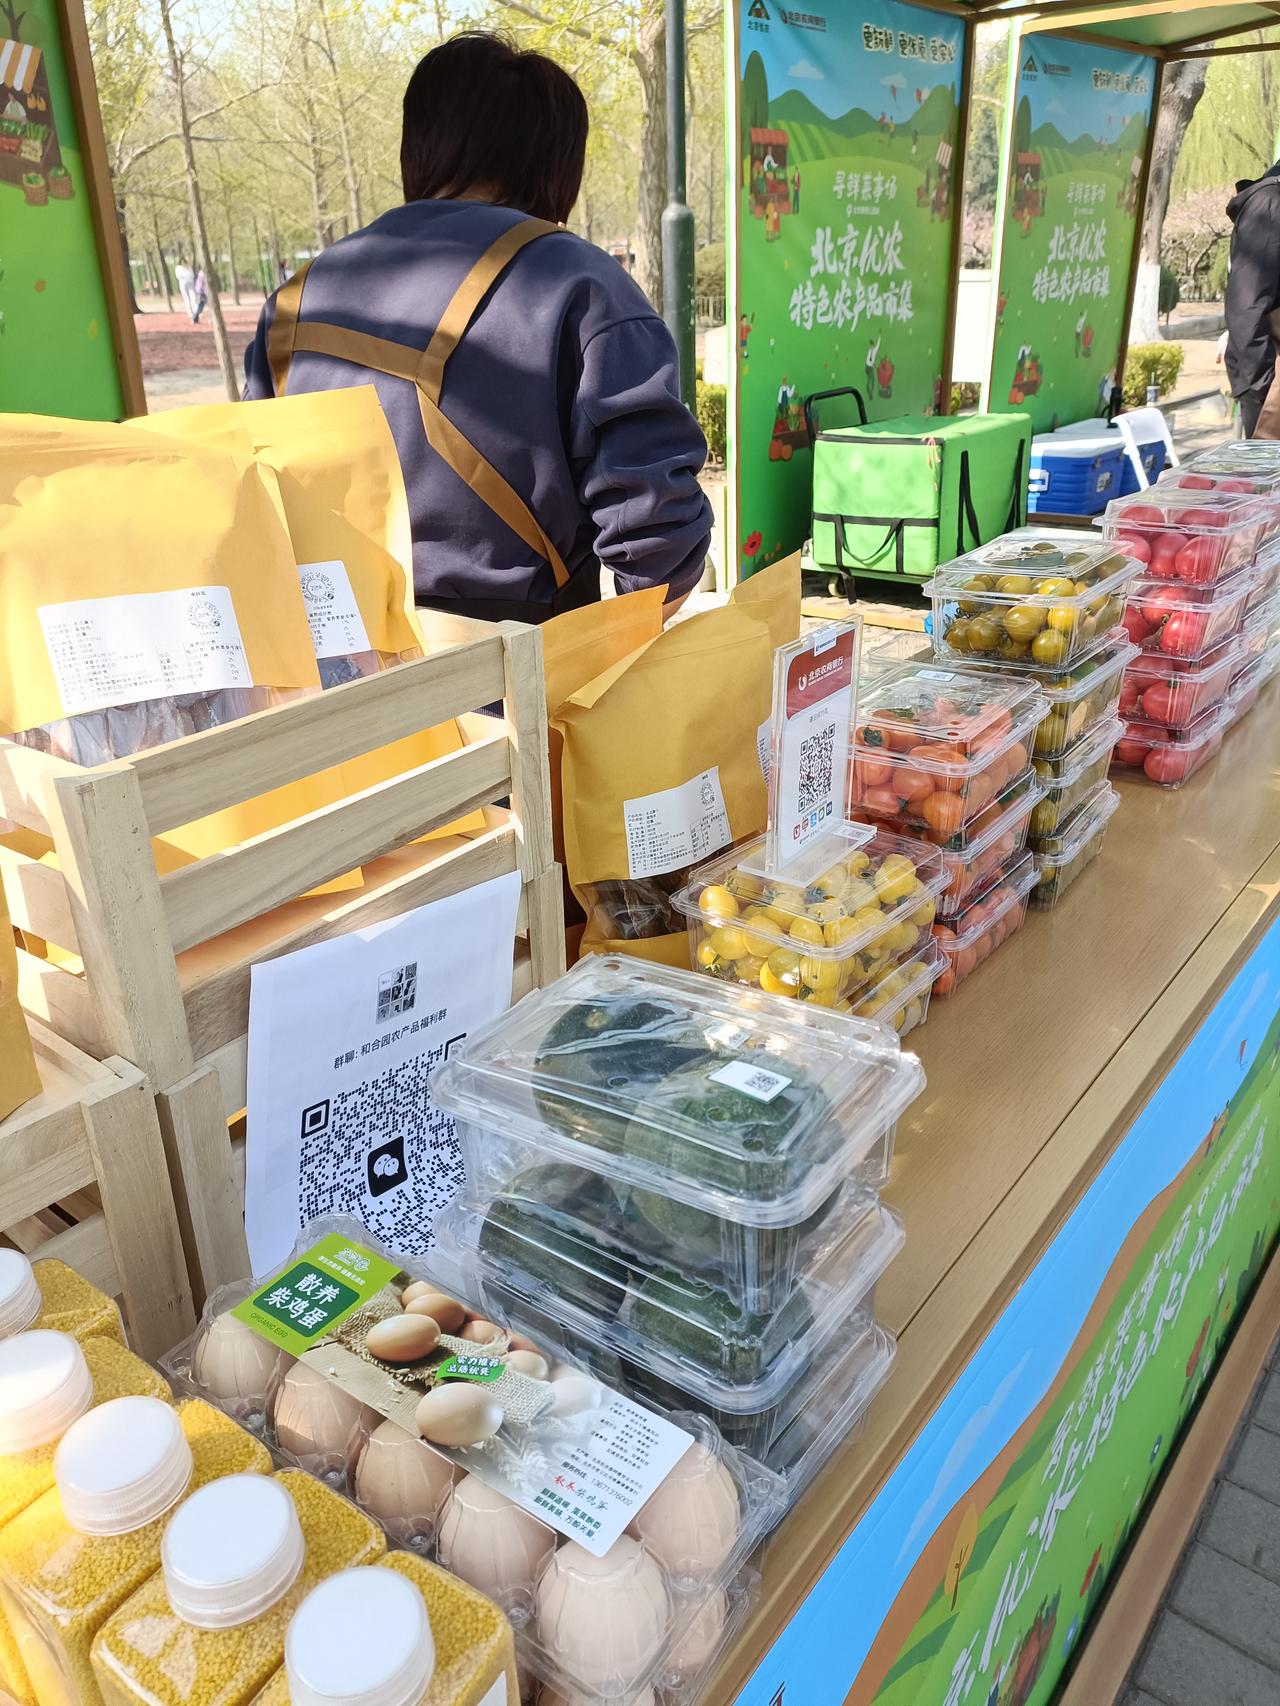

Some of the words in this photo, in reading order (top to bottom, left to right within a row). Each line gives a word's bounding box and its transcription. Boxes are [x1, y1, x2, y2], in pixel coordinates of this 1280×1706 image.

[810, 219, 906, 279] 北京优农
[1048, 221, 1107, 265] 北京优农
[788, 276, 915, 333] 特色农产品市集
[1032, 262, 1110, 306] 特色农产品市集
[808, 655, 844, 682] 北京农商银行
[263, 1286, 329, 1329] 柴鸡蛋
[294, 1272, 341, 1305] 散养
